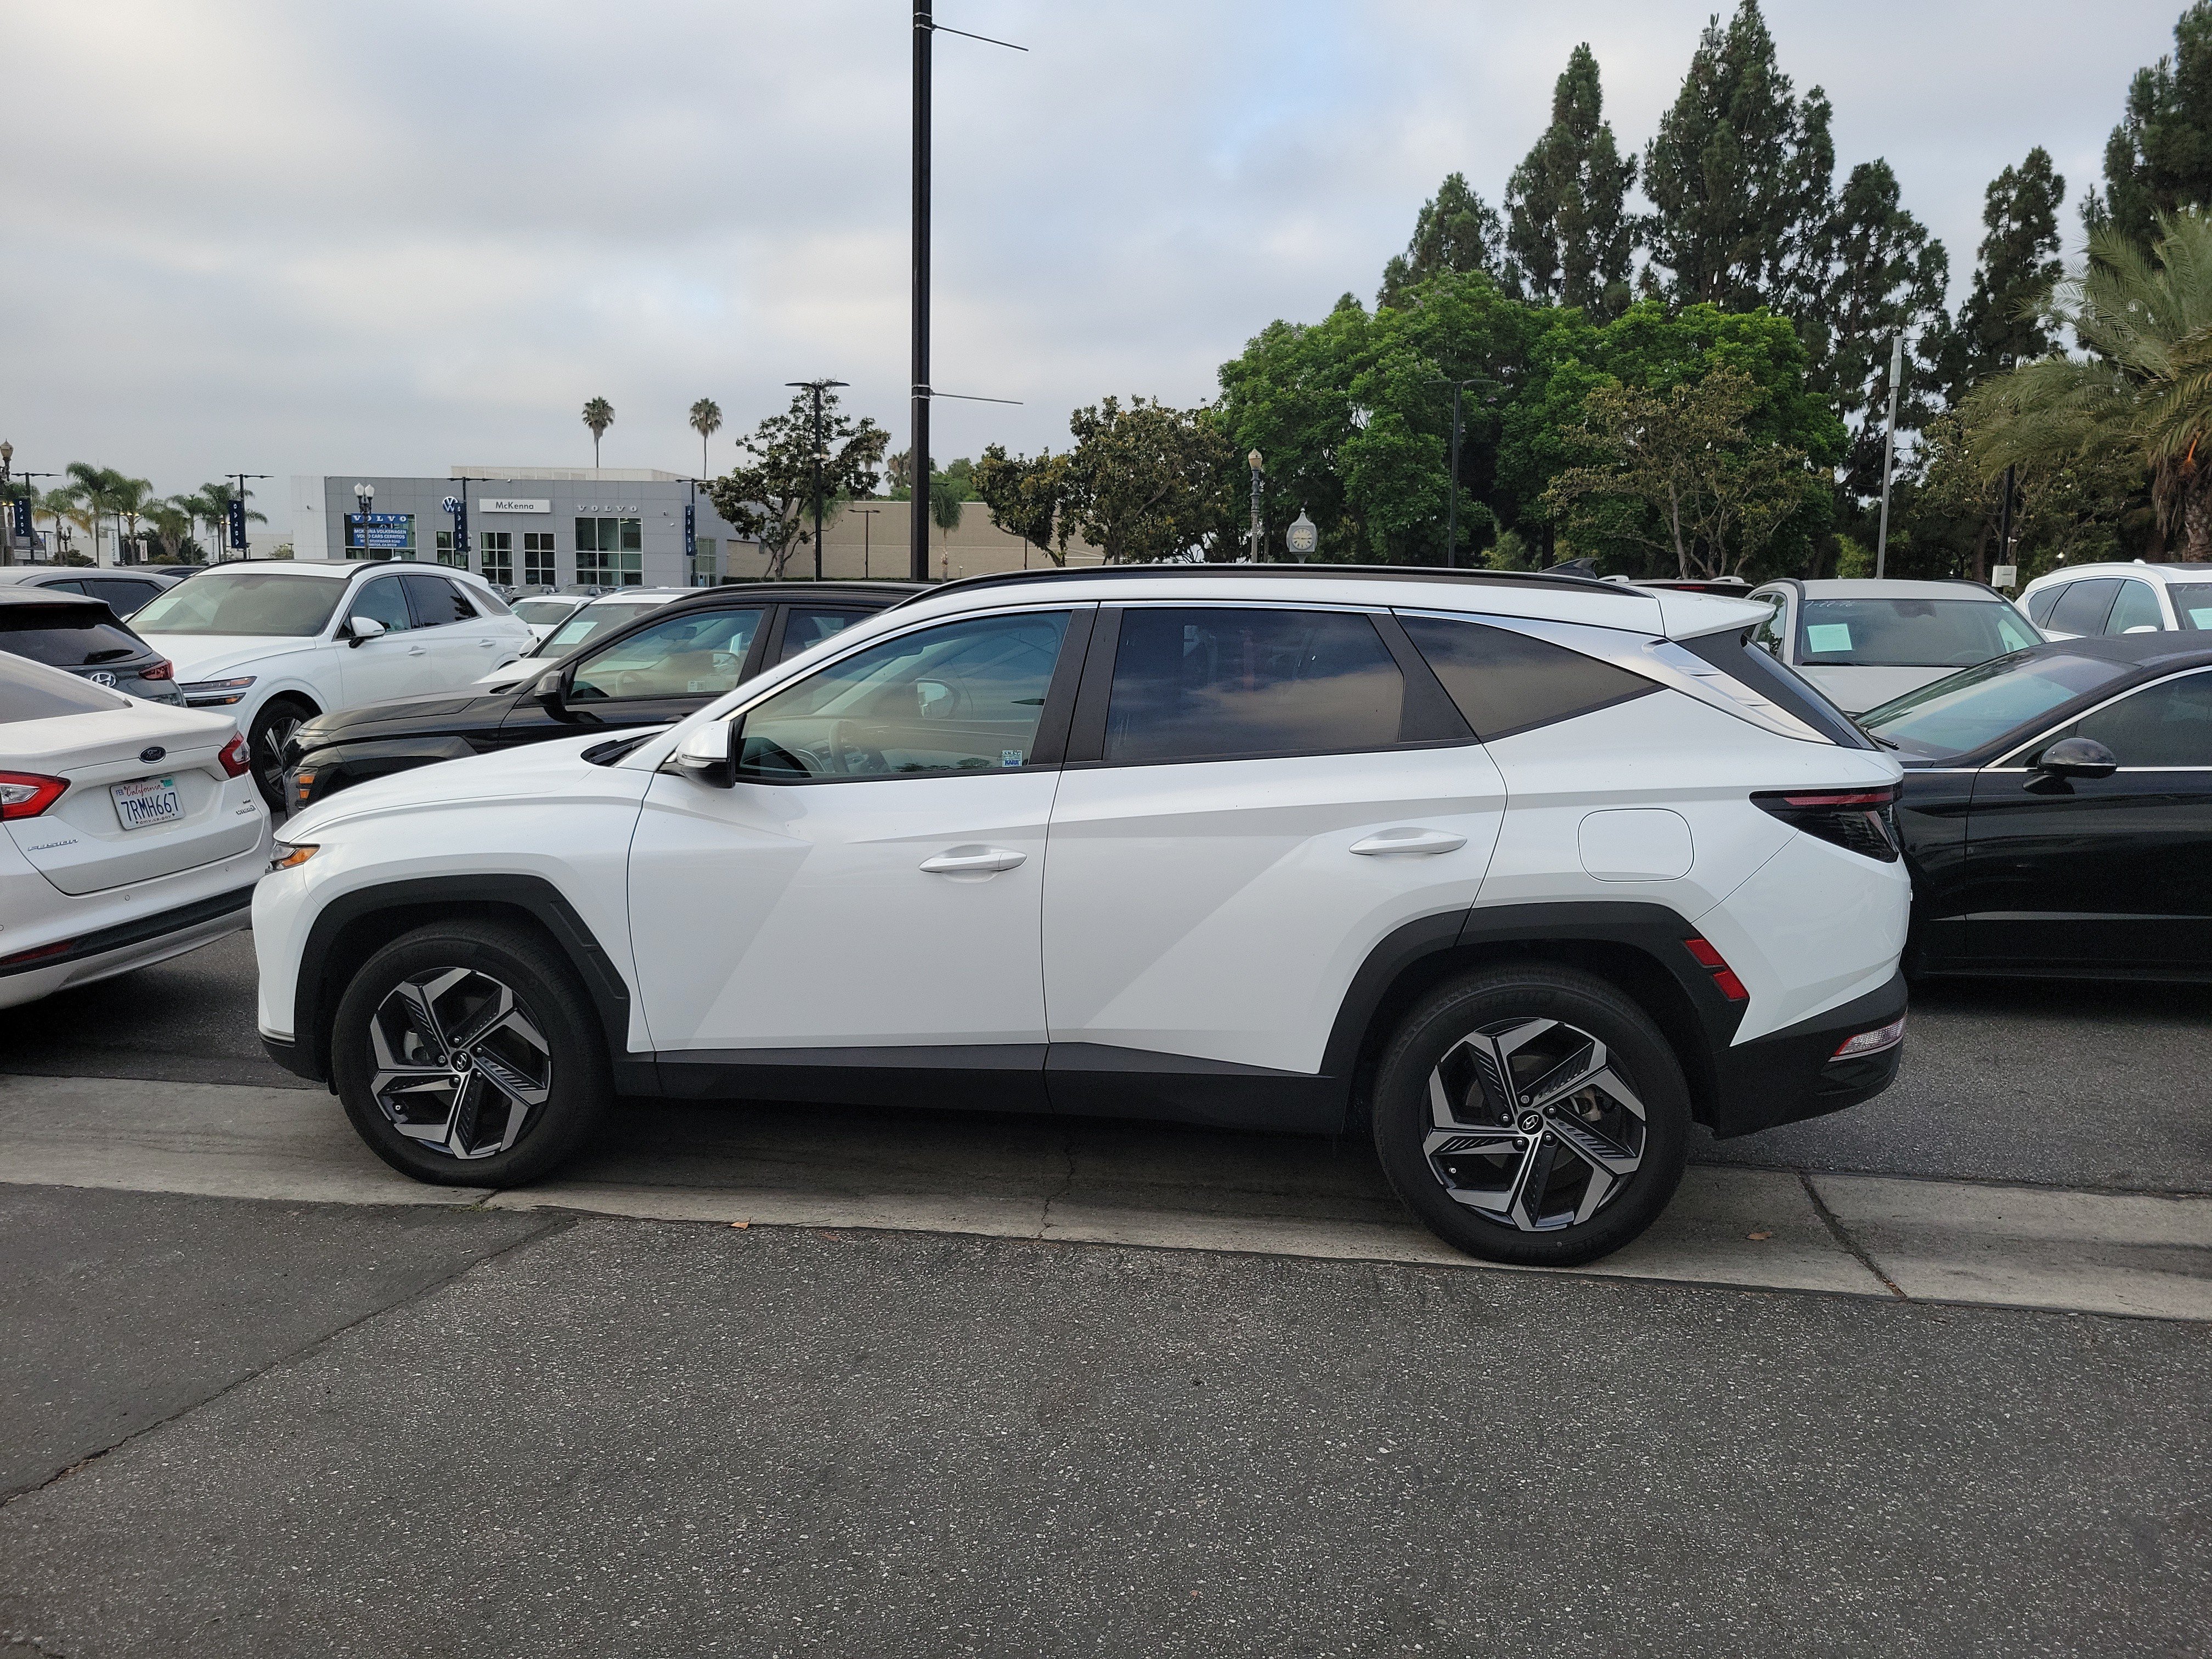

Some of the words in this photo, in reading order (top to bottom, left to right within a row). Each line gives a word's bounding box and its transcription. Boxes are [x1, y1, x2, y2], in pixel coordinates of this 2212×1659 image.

[126, 783, 165, 797] California
[121, 792, 179, 822] 7RMH667
[139, 815, 171, 825] dmv.ca.gov
